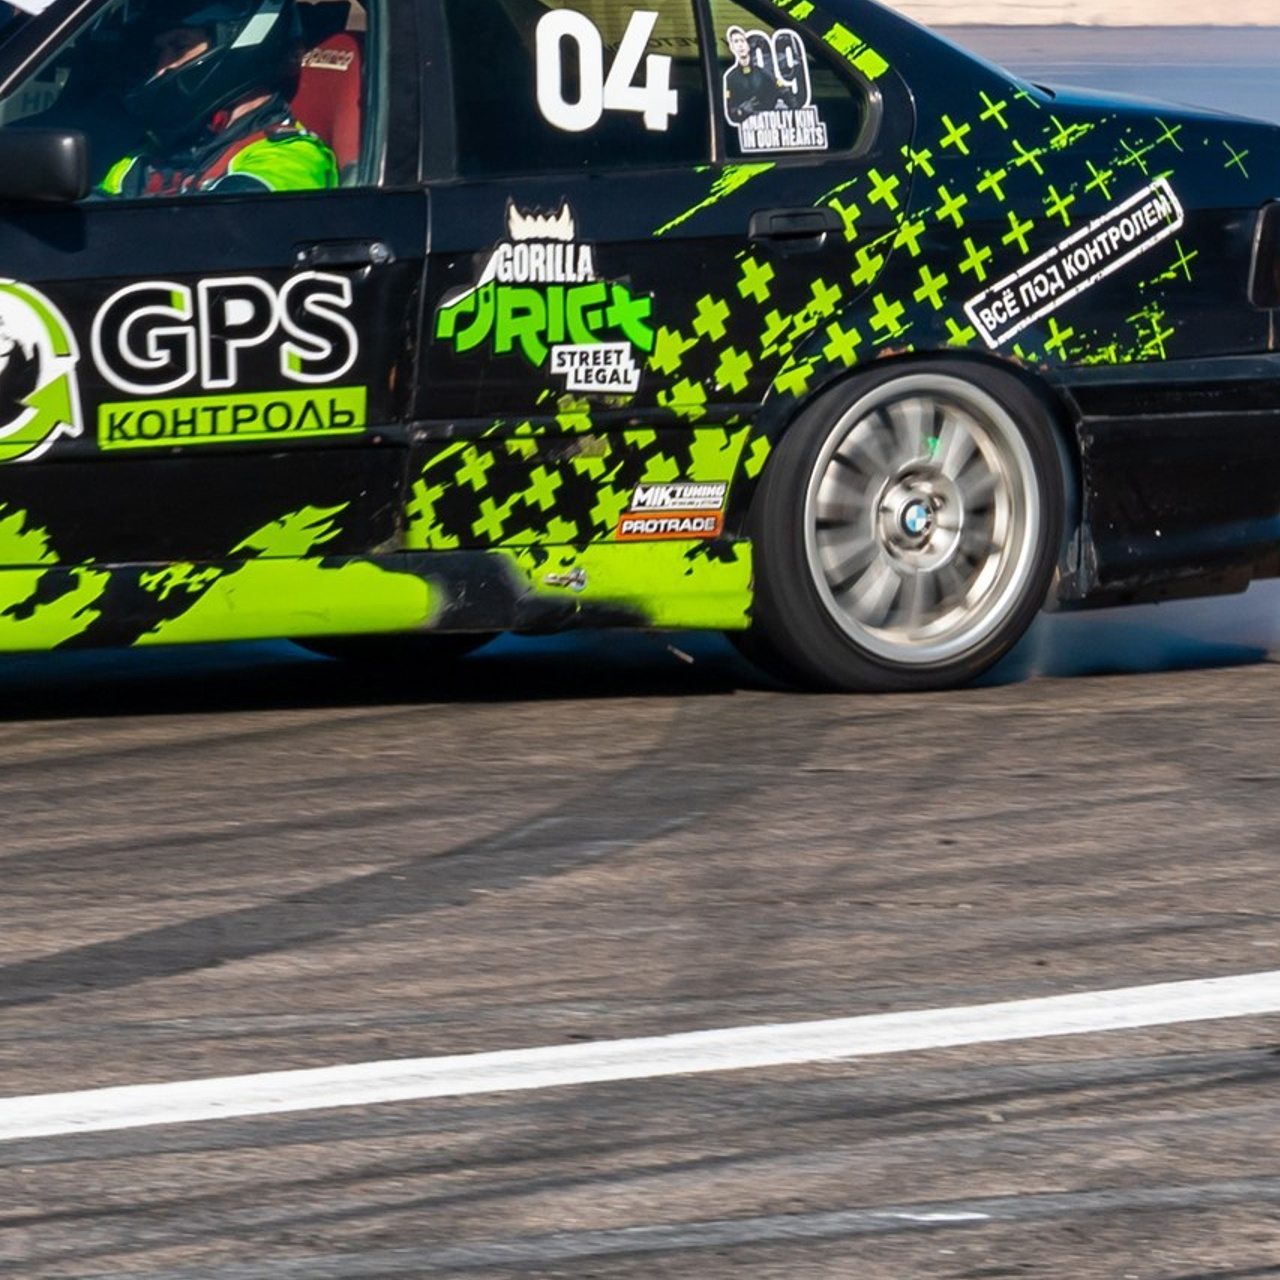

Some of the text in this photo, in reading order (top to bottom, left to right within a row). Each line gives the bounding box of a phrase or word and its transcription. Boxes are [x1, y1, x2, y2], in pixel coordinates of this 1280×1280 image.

[535, 8, 679, 132] 04
[743, 126, 825, 148] IN OUR HEARTS
[496, 242, 596, 283] GORILLA
[978, 194, 1173, 332] ВСЁ ПОД КОНТРОЛЕМ
[90, 270, 360, 396] GPS
[556, 349, 625, 368] STREET
[573, 369, 633, 385] LEGAL
[107, 397, 356, 442] КОНТРОЛЬ
[621, 516, 717, 535] PROTRADE
